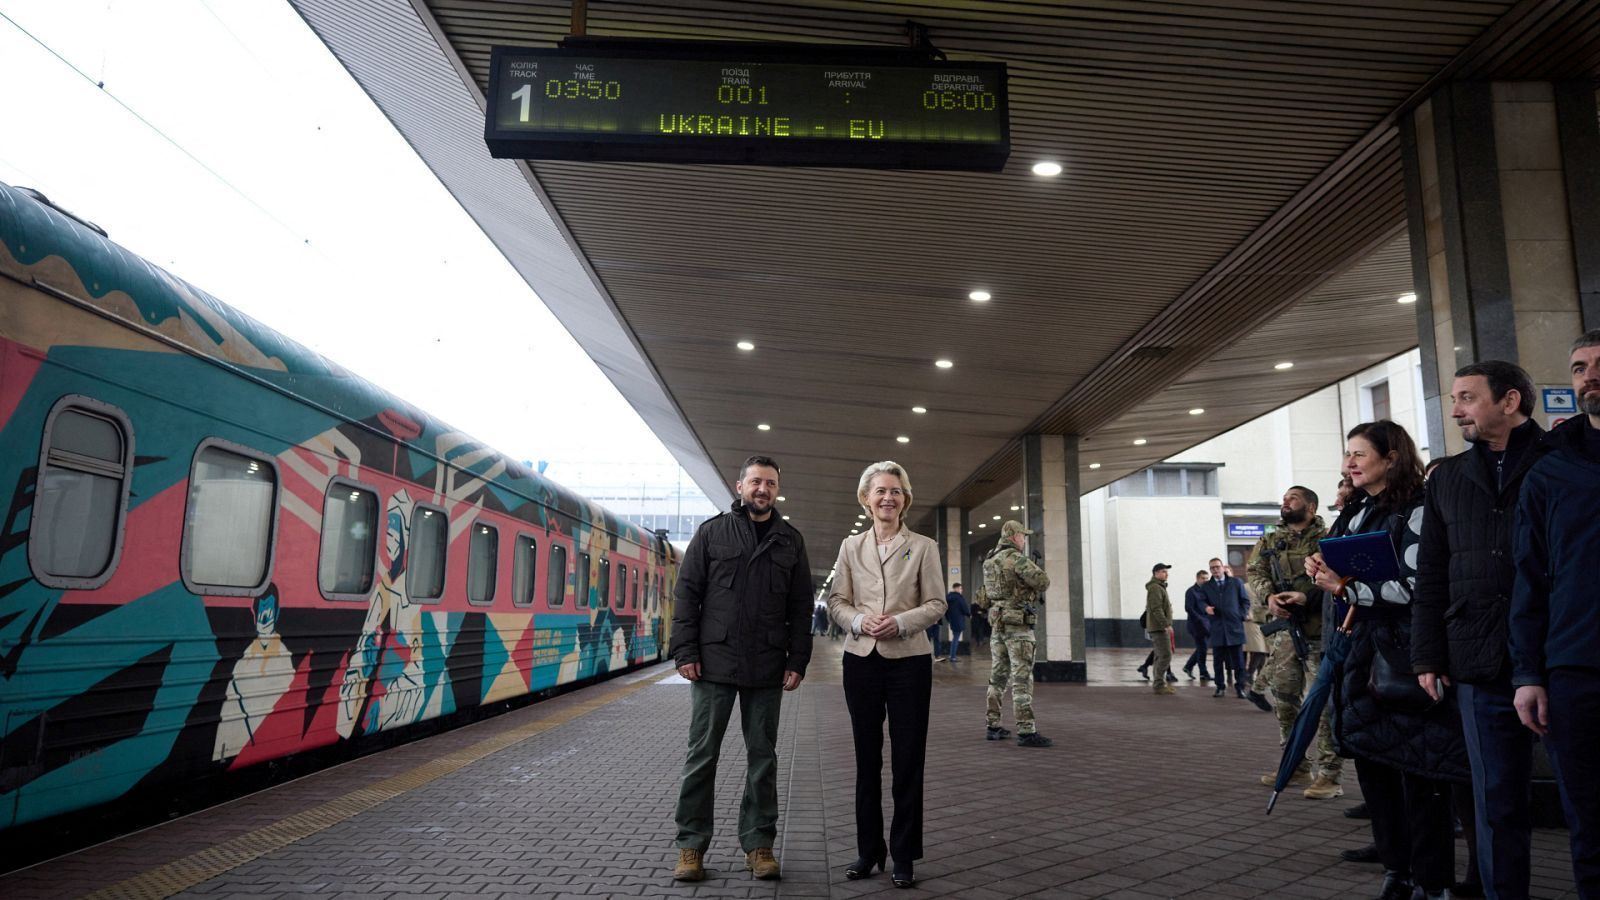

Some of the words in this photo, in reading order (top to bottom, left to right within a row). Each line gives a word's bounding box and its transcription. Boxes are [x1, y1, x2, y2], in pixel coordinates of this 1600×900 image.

[511, 62, 538, 70] КОЛІЯ
[509, 70, 537, 78] TRACK
[573, 72, 595, 80] TIME
[721, 67, 750, 78] ПОЇЗД
[824, 71, 871, 81] ПРИБУТТЯ
[721, 77, 750, 85] TRAIN
[933, 74, 983, 83] ВІДПРАВЛ.
[829, 80, 867, 89] ARRIVAL
[931, 83, 985, 92] DEPARTURE
[545, 79, 621, 100] 03:50
[718, 85, 768, 105] 001
[511, 84, 531, 122] 1
[923, 91, 996, 111] 06:00
[660, 113, 790, 137] UKRAINE
[849, 119, 884, 139] EU
